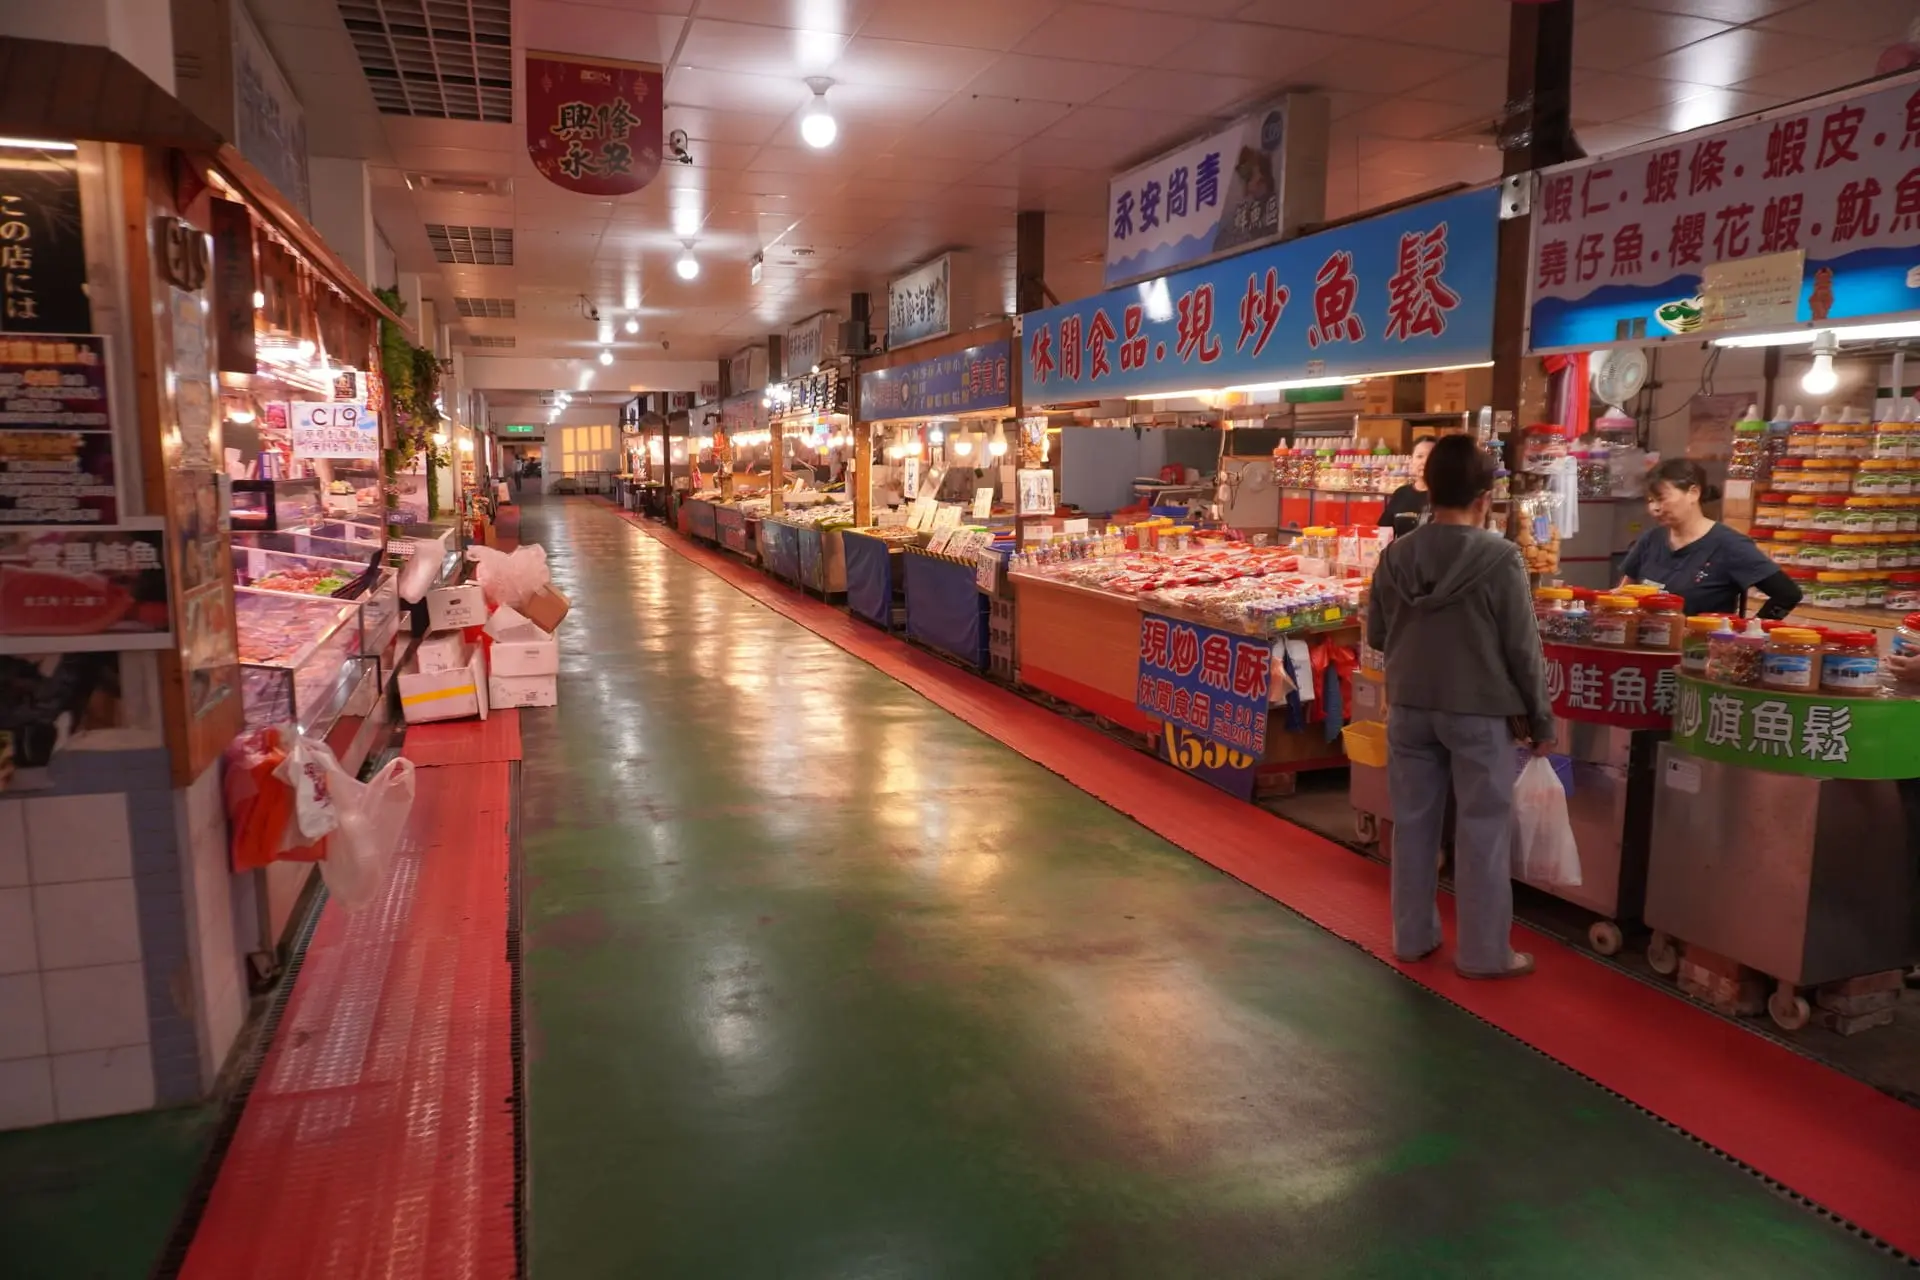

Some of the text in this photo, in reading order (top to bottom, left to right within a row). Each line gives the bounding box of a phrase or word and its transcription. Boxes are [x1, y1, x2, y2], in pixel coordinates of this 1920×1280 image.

[551, 98, 641, 140] 興隆
[559, 141, 633, 178] 永安
[311, 408, 357, 427] C19
[1140, 617, 1271, 701] 現炒魚酥
[1138, 672, 1212, 735] 休閒食品
[1676, 684, 1853, 764] 炒旗魚鬆
